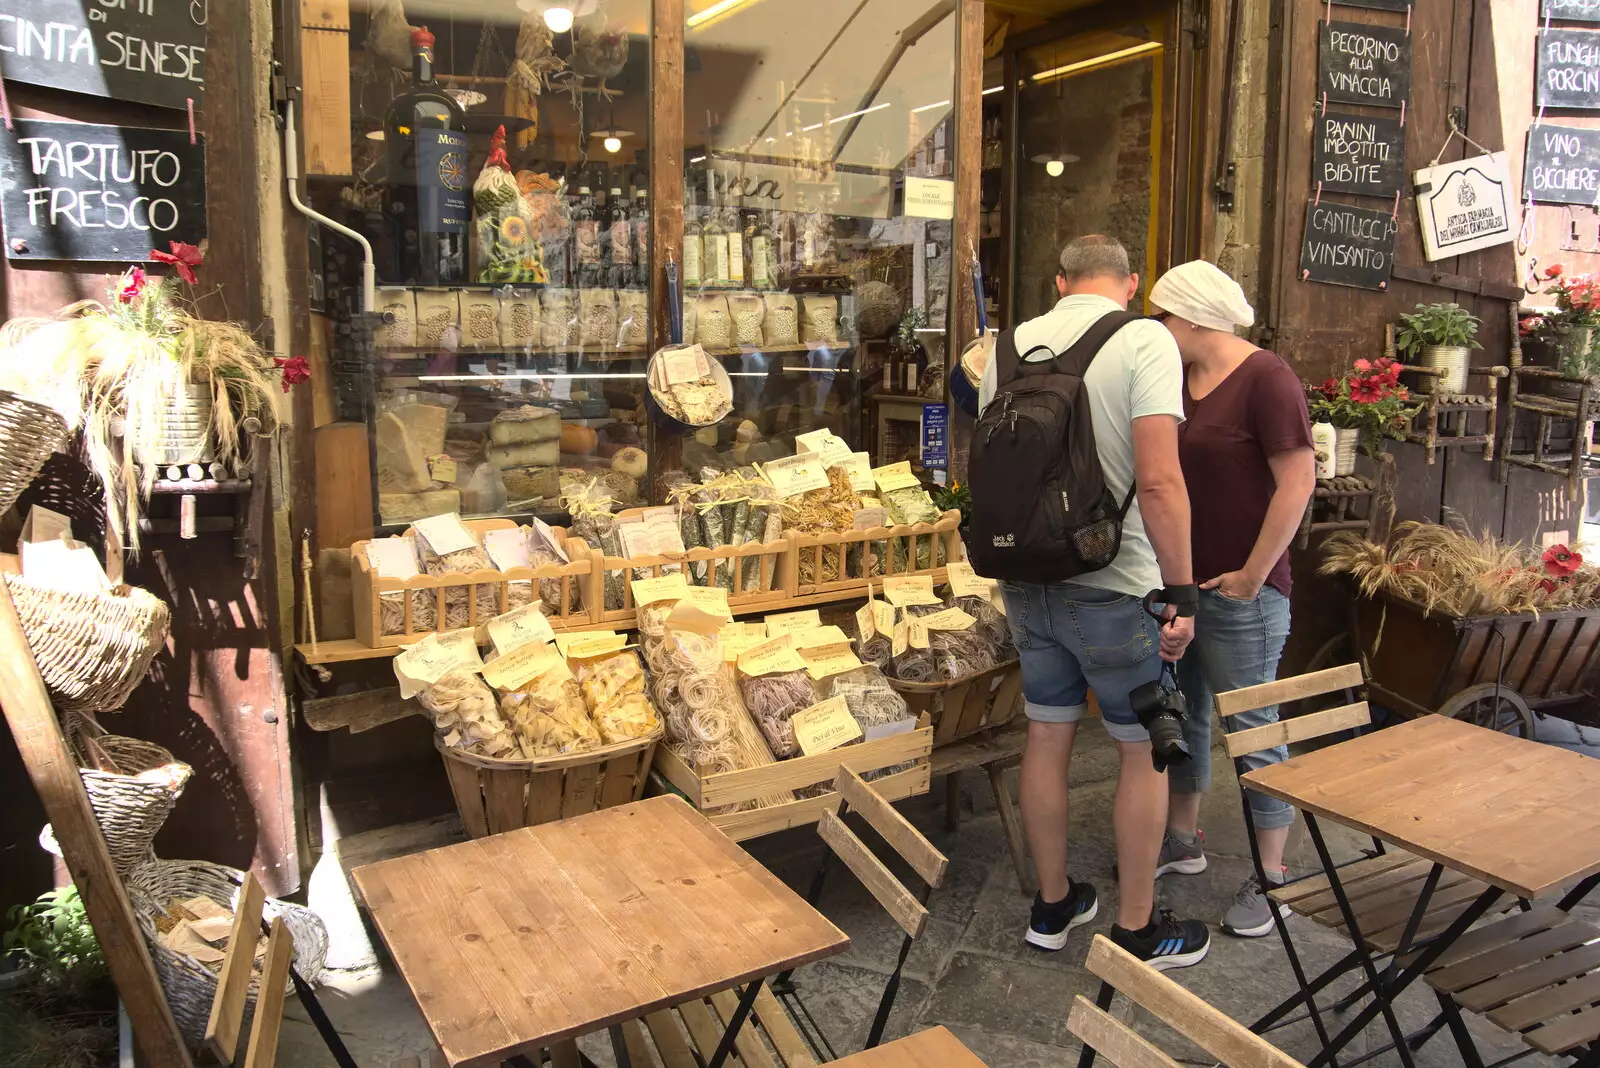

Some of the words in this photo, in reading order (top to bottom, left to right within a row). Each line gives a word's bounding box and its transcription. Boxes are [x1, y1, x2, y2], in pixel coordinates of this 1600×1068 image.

[88, 8, 108, 23] DI
[0, 15, 95, 66] CINTA
[100, 31, 206, 82] SENESE
[1330, 31, 1399, 62] PECORINO
[1547, 41, 1600, 67] FUNGH
[1349, 56, 1374, 71] ALLA
[1329, 71, 1392, 98] VINACCIA
[1326, 119, 1376, 142] PANINI
[1324, 138, 1390, 161] IMBOTTITI
[1544, 132, 1581, 157] VINO
[18, 137, 181, 187] TARTUFO
[1351, 155, 1359, 164] E
[1324, 163, 1382, 183] BIBITE
[1533, 166, 1600, 190] BICCHIERE
[23, 187, 179, 231] FRESCO
[1313, 209, 1388, 240] CANTUCCI
[1308, 241, 1385, 269] VINSANTO
